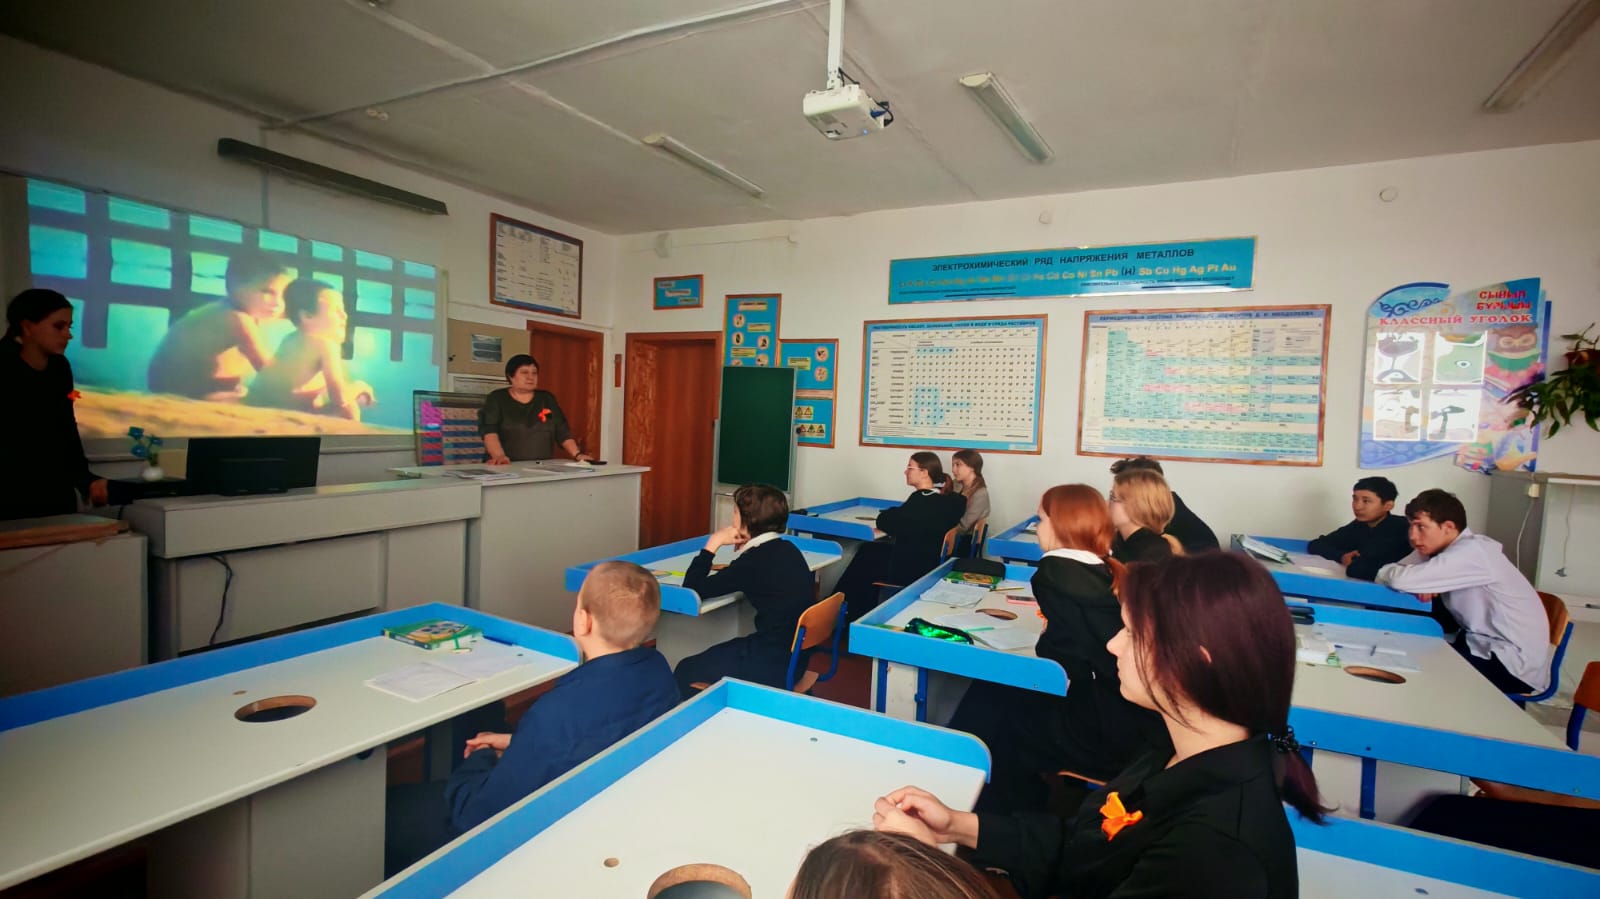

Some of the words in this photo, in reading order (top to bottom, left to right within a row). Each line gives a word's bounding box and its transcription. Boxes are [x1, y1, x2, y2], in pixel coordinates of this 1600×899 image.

[932, 259, 1028, 272] ЭЛЕКТРОХИМИЧЕСКИЙ
[1034, 257, 1054, 266] РЯД
[1060, 252, 1128, 264] НАПРЯЖЕНИЯ
[1136, 248, 1194, 259] МЕТАЛЛОВ
[1104, 268, 1118, 277] Pb
[1138, 267, 1152, 276] Sb
[1155, 266, 1169, 275] Cu
[1172, 265, 1187, 276] Hg
[1189, 265, 1205, 275] Ag
[1207, 264, 1219, 272] Pt
[1221, 263, 1237, 271] Au
[1379, 314, 1463, 326] КЛАССНЫЙ
[1470, 314, 1532, 324] УГОЛОК
